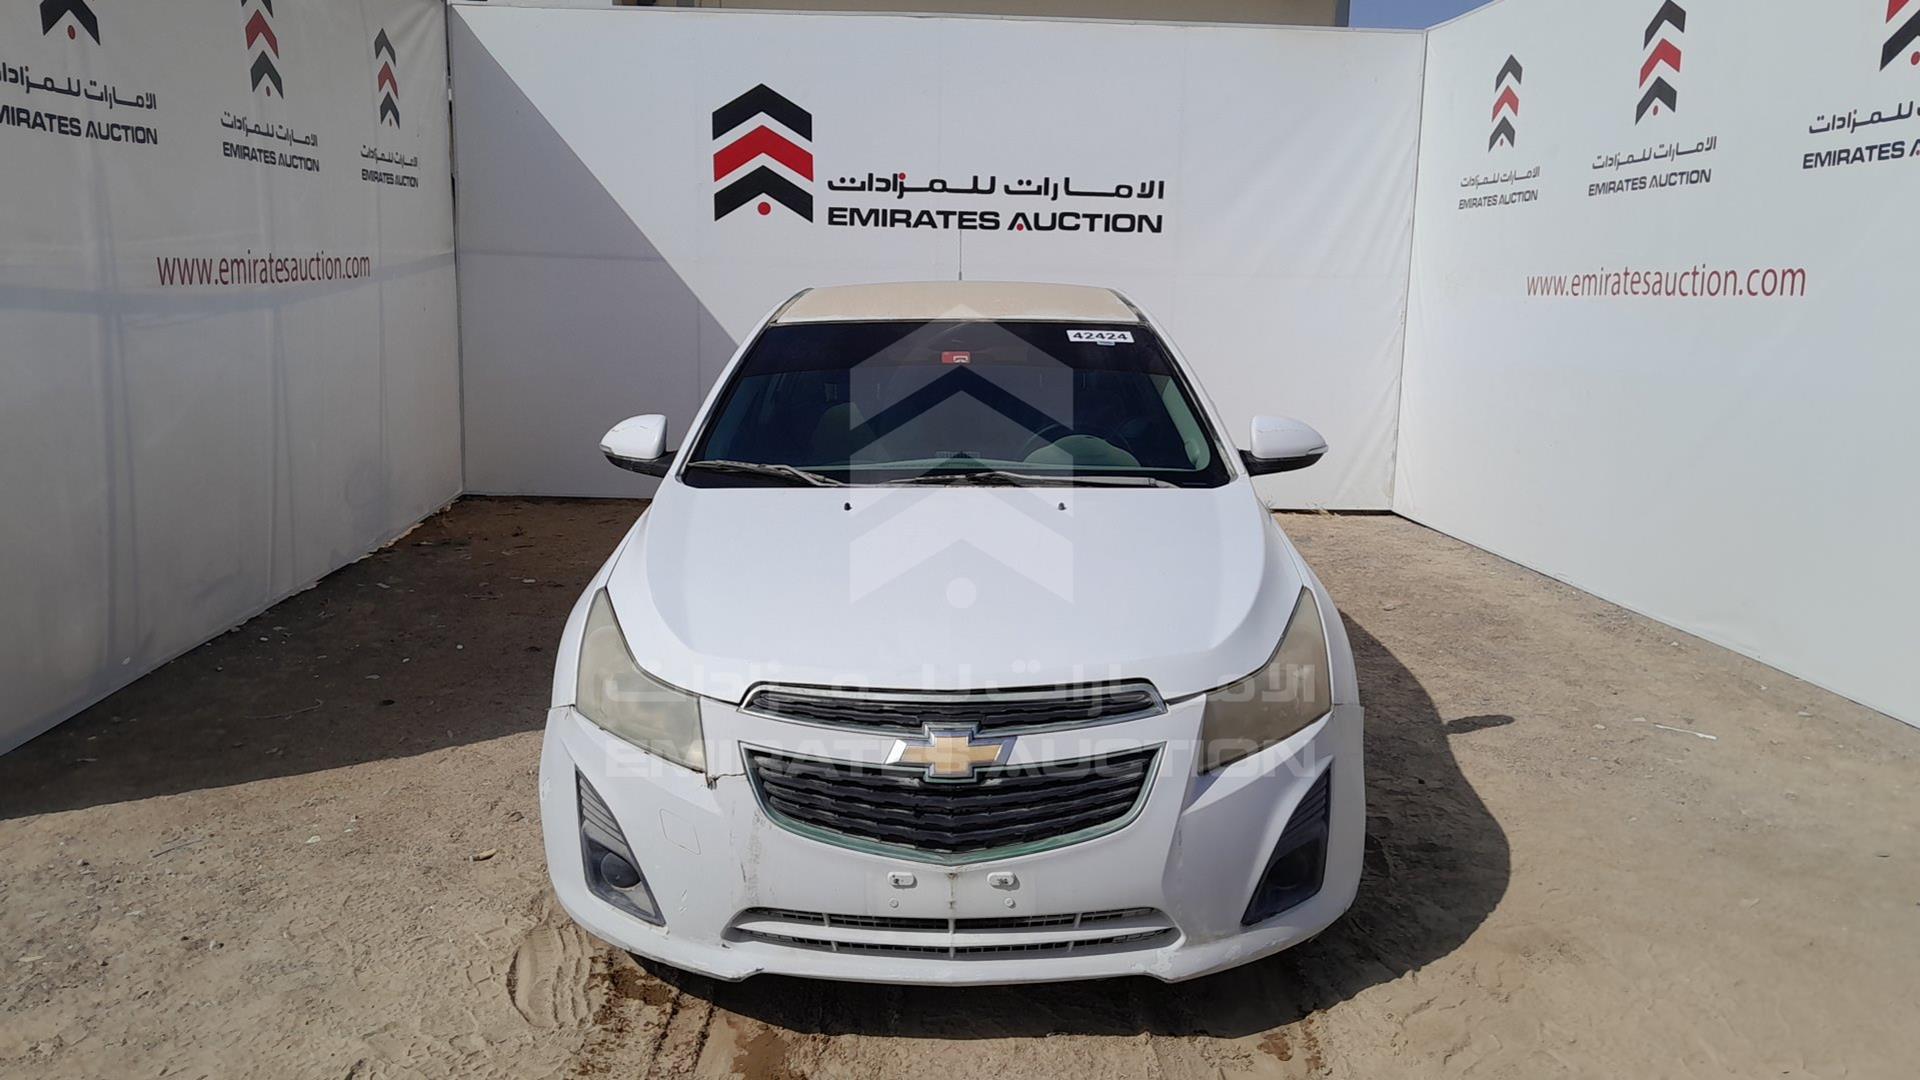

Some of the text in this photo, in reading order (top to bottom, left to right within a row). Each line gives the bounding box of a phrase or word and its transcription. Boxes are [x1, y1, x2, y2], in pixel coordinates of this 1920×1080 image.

[0, 104, 158, 145] MIRATES AUCTION
[222, 141, 320, 173] EMIRATES AUCTION
[1802, 140, 1906, 169] EMIRATES
[361, 168, 419, 188] EMIRATES AUCTION
[1588, 168, 1712, 197] EMIRATES AUCTION
[1458, 189, 1538, 210] EMIRATES AUCTION
[827, 207, 1163, 234] EMIRATES AUCTION
[156, 249, 371, 286] www.emiratesauction.com
[1526, 263, 1807, 297] www.emiratesauction.com
[1072, 331, 1128, 341] 42424
